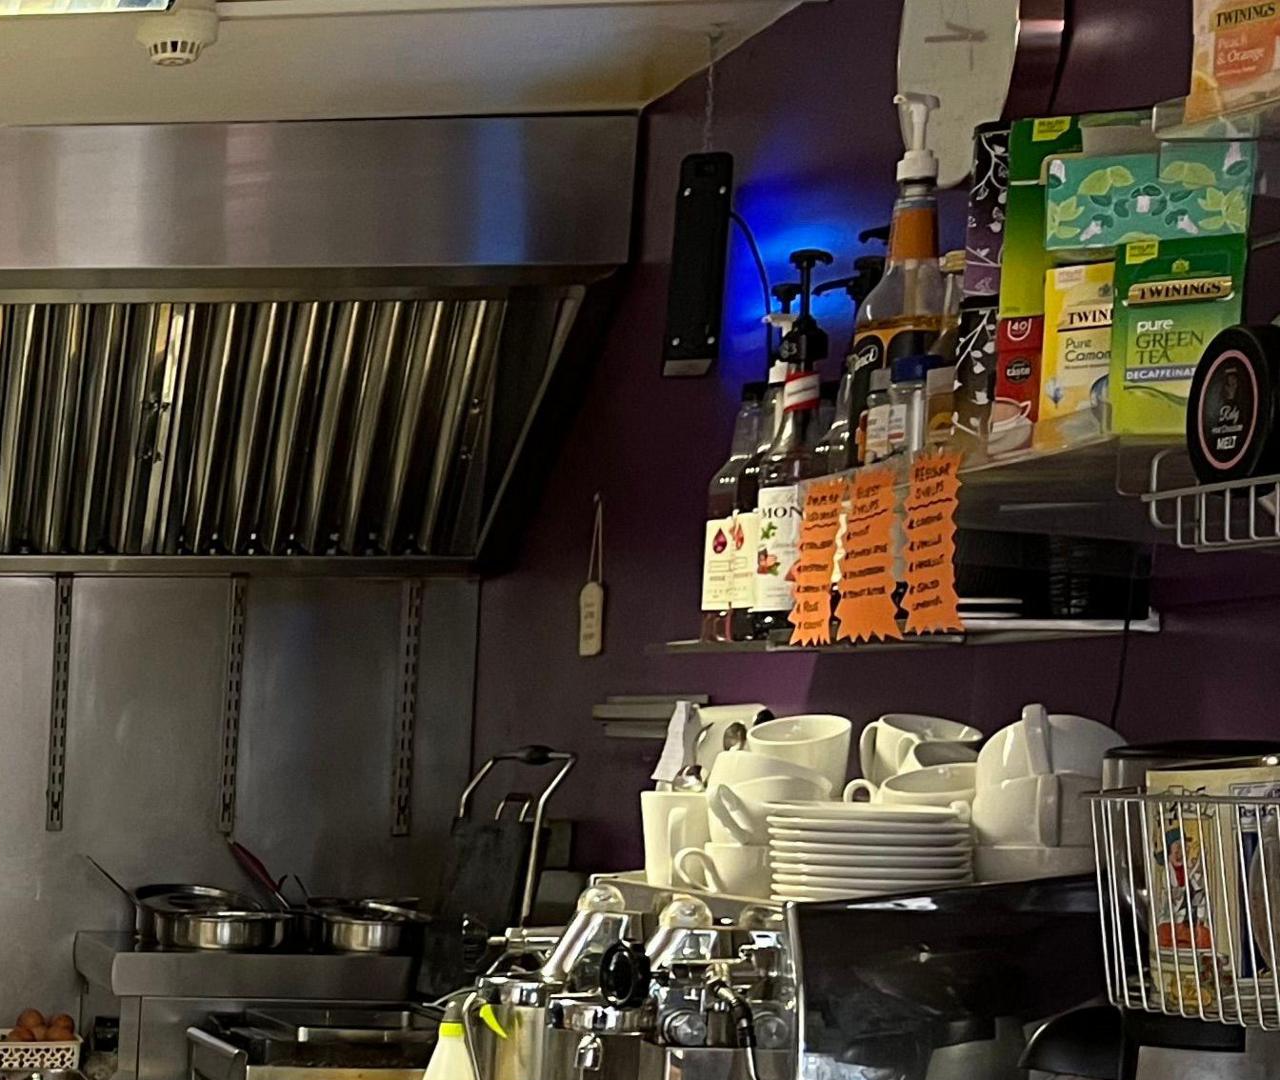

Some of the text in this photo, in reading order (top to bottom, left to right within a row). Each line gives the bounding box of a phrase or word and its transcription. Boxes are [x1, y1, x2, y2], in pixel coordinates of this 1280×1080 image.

[1217, 3, 1276, 27] TWININGS
[1139, 282, 1222, 300] TWININGS
[1137, 319, 1173, 334] pure
[1065, 337, 1093, 349] Pure
[1135, 330, 1205, 350] GREEN
[1137, 349, 1171, 365] TEA
